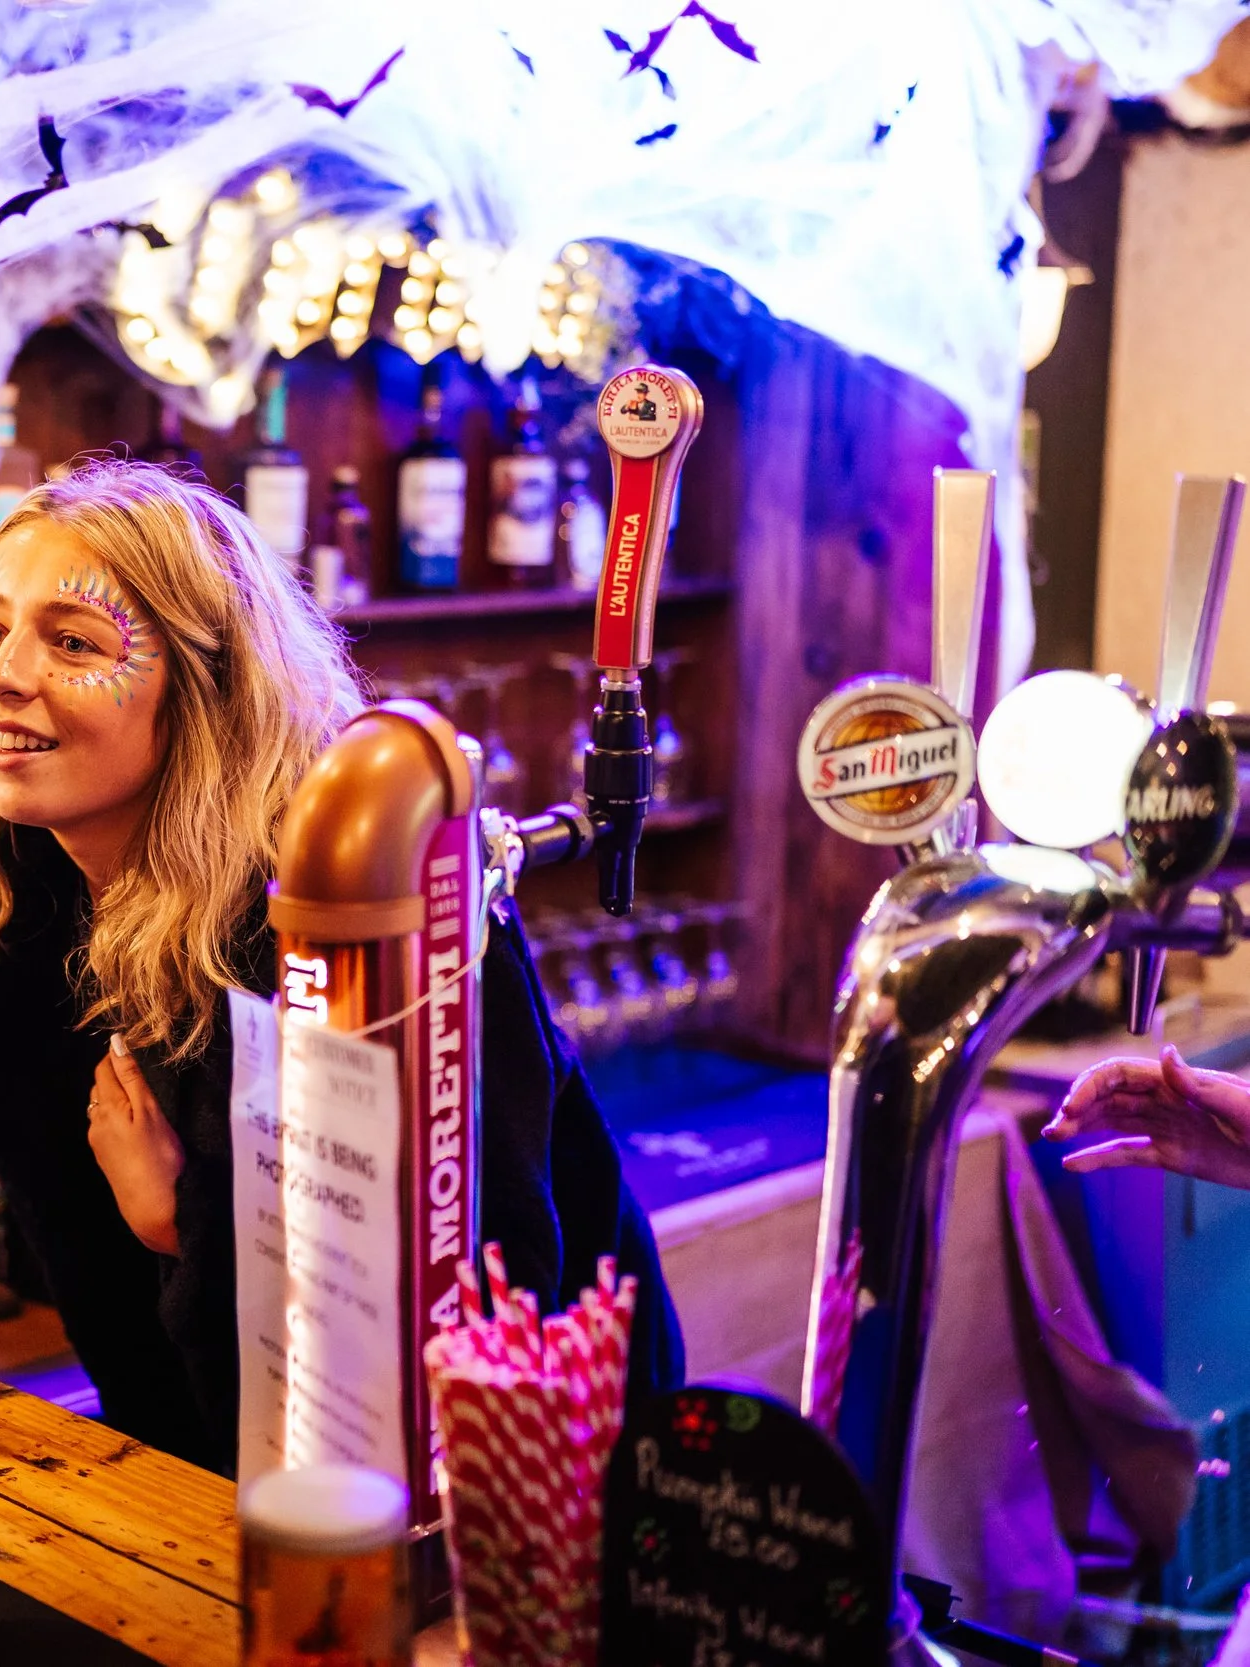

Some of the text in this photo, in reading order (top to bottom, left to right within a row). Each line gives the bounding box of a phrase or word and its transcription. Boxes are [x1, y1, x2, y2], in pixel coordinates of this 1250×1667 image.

[603, 371, 678, 420] BIRRA MORETTI
[610, 426, 668, 438] L'AUTENTICA
[609, 512, 641, 617] L'AUTENTICA
[812, 735, 958, 792] San Miguel
[1125, 783, 1216, 824] ARLING
[428, 945, 462, 1268] MORETTI
